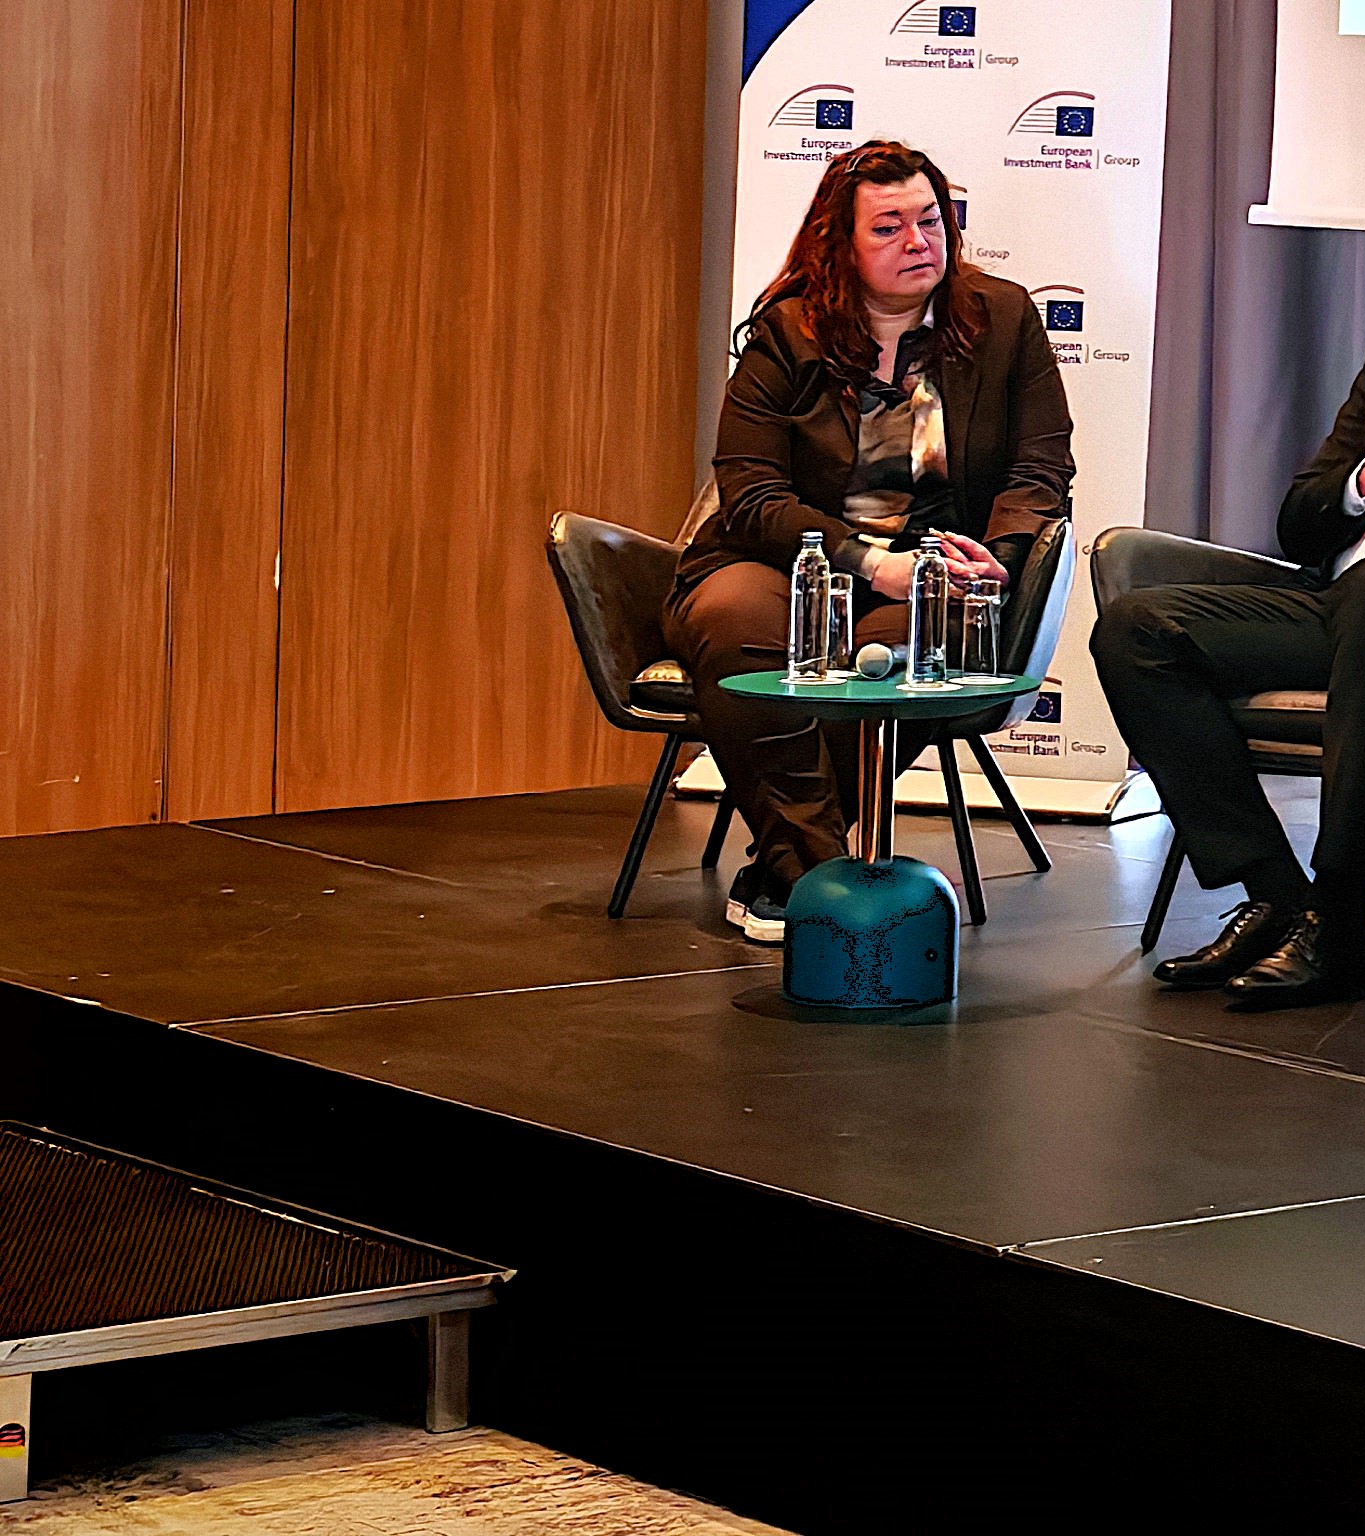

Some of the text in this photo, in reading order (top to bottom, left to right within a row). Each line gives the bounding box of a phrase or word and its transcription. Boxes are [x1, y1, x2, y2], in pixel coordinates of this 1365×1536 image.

[924, 44, 975, 58] European
[885, 57, 975, 70] Investment Bank
[985, 53, 1019, 68] Group
[801, 137, 853, 151] European
[763, 150, 823, 162] Investment
[1040, 145, 1093, 158] European
[1003, 157, 1092, 170] Investment Bank
[1104, 154, 1141, 168] Group
[976, 247, 1010, 260] Group
[1093, 349, 1130, 362] Group
[1009, 729, 1061, 743] European
[1033, 745, 1060, 757] Bank
[1071, 741, 1107, 756] Group
